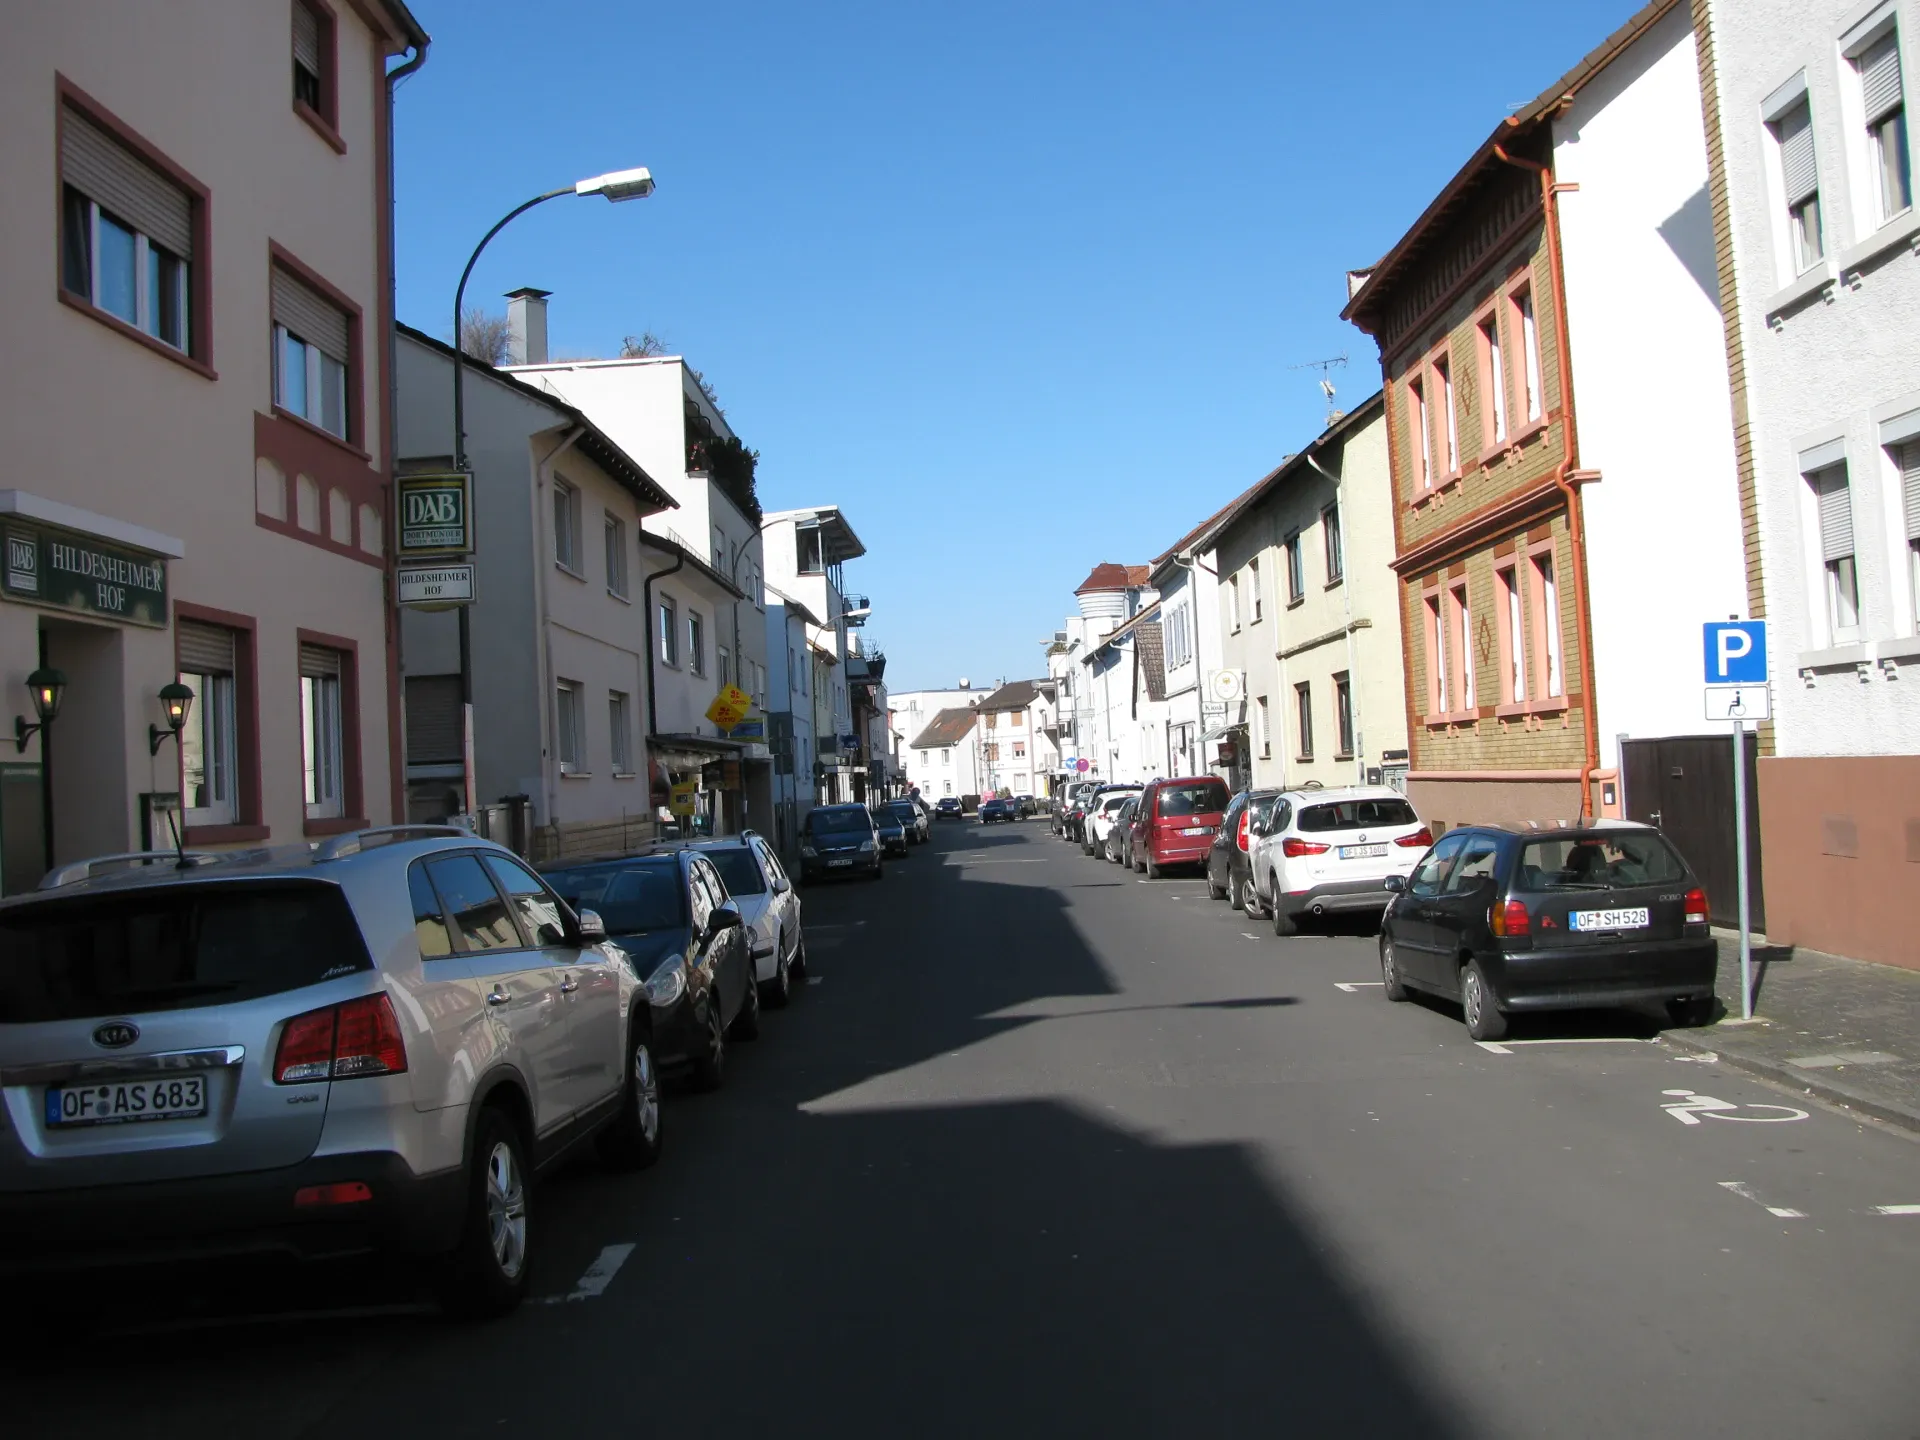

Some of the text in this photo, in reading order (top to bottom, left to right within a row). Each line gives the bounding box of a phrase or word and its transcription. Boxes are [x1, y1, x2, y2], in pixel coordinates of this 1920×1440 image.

[408, 494, 456, 523] DAB
[11, 543, 34, 570] DAB
[52, 543, 162, 592] HILDESHEIMER
[401, 573, 468, 584] HILDESHEIMER
[424, 586, 443, 595] HOF
[97, 583, 126, 611] HOF
[1717, 628, 1752, 676] P
[1344, 848, 1353, 856] OF
[1578, 910, 1647, 927] OF SH 528
[101, 1027, 131, 1042] KIA
[63, 1090, 95, 1117] OF
[113, 1086, 147, 1113] AS
[153, 1081, 200, 1109] 683
